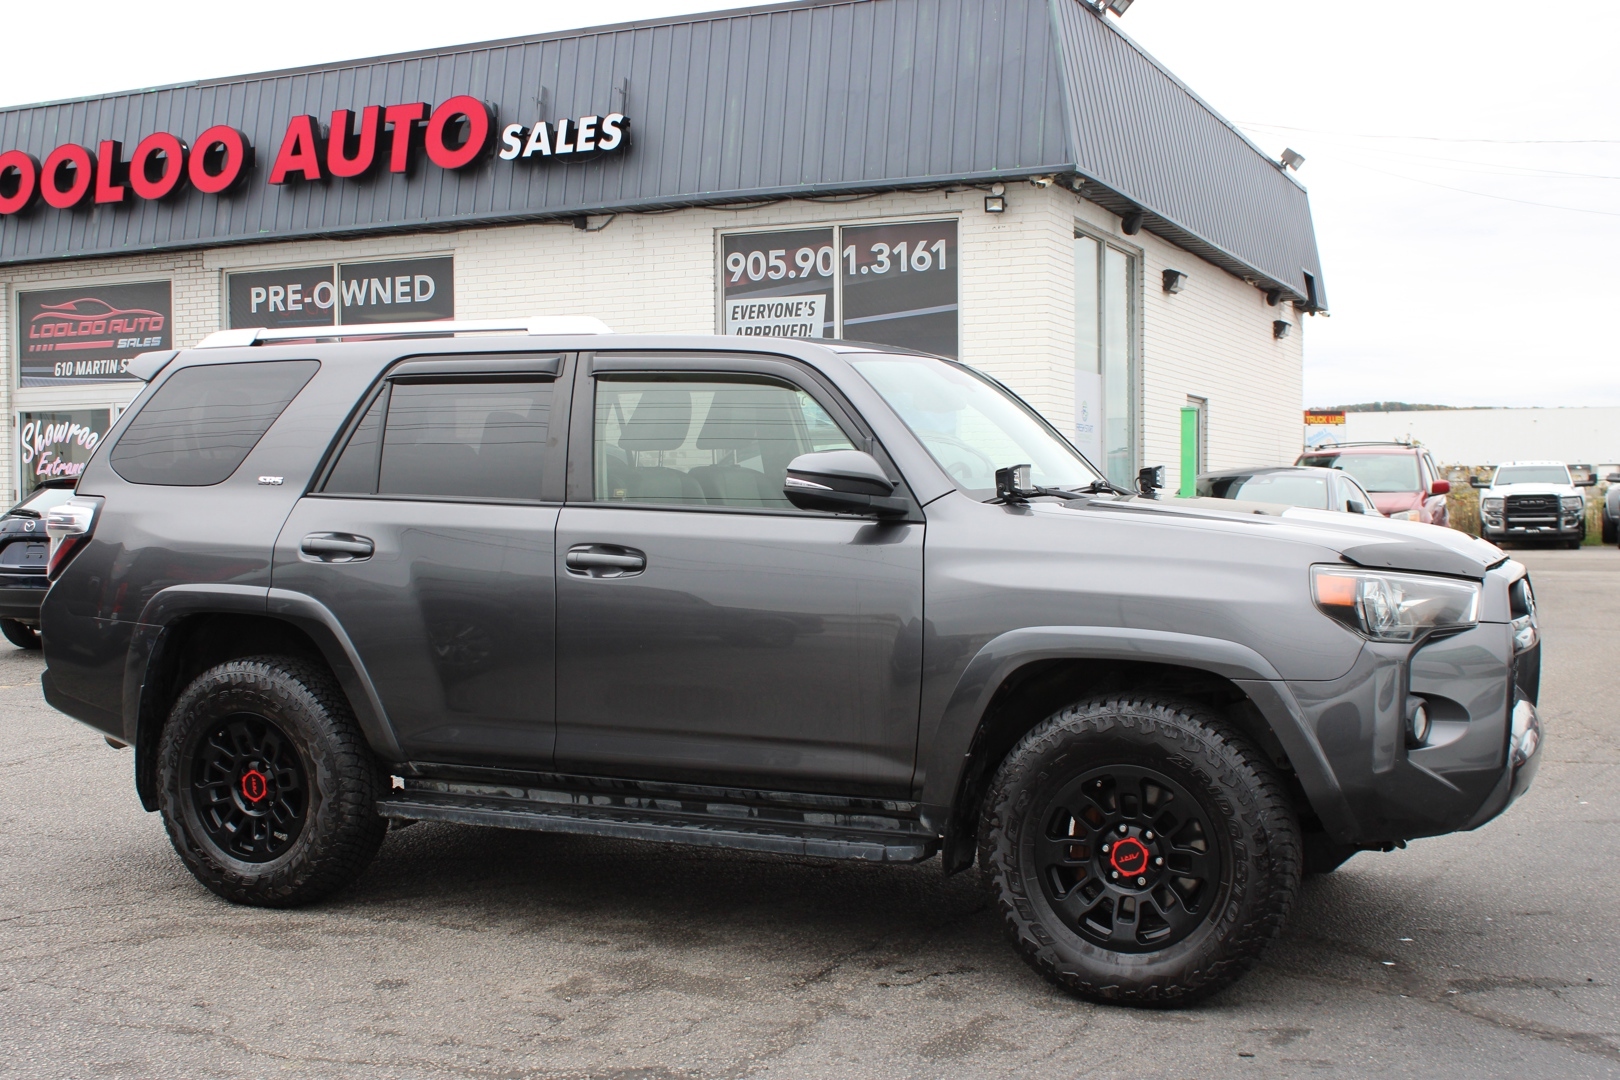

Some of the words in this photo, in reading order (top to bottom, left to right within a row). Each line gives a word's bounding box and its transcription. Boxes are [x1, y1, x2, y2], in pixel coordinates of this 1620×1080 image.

[0, 125, 243, 215] OOLOO
[268, 95, 488, 185] AUTO
[500, 113, 624, 161] SALES
[726, 239, 947, 283] 905.901.3161
[251, 275, 436, 314] PRE-OWNED
[731, 301, 816, 321] EVERYONE'S
[29, 320, 107, 339] LOOLOO
[108, 316, 165, 335] AUTO
[117, 336, 162, 349] SALES
[54, 361, 73, 377] 610
[75, 359, 118, 376] MARTIN
[119, 358, 134, 374] S
[1306, 415, 1327, 424] TRUCK
[21, 420, 101, 464] Showroo
[36, 451, 86, 476] Entranc
[258, 475, 284, 486] SR5
